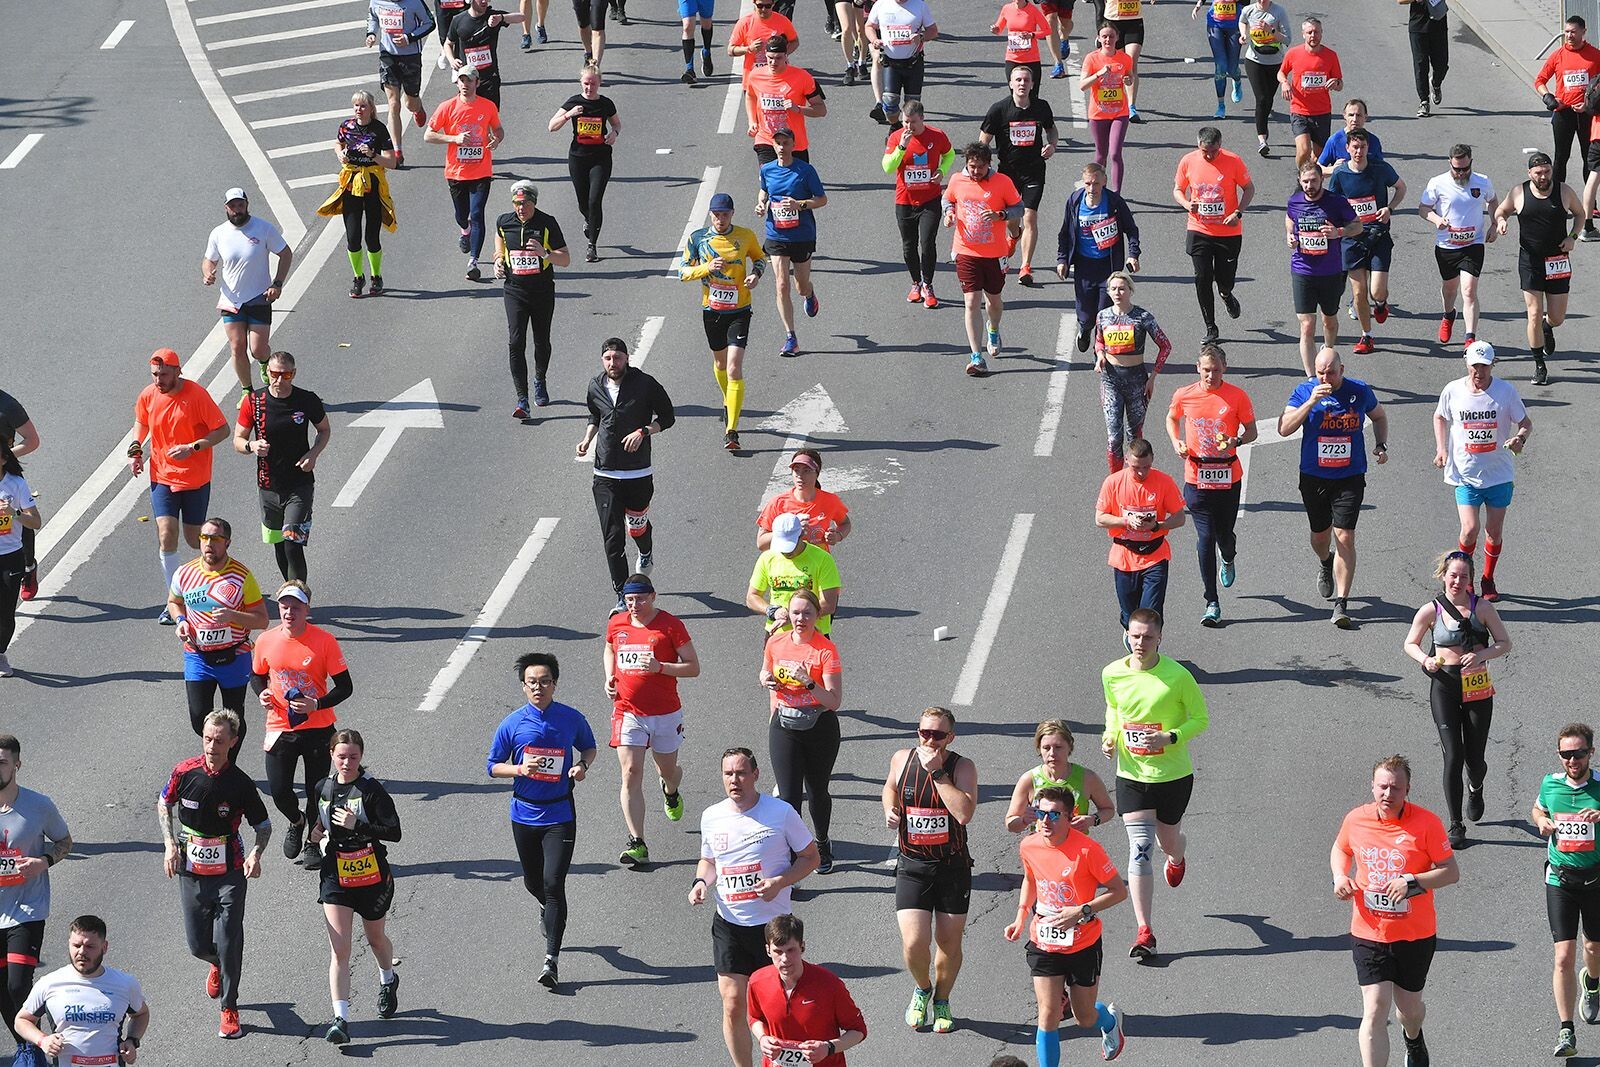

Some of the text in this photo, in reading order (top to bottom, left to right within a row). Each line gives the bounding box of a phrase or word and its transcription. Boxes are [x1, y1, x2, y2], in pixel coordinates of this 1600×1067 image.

[1119, 1, 1138, 10] 13001
[1214, 2, 1234, 11] 14961
[468, 52, 490, 63] 18481
[1304, 76, 1324, 84] 7123
[1566, 74, 1586, 82] 4055
[1103, 90, 1118, 98] 220
[579, 122, 601, 132] 16789
[1012, 130, 1034, 138] 18334
[458, 147, 482, 156] 17368
[906, 170, 928, 180] 9195
[1199, 203, 1224, 212] 15514
[1450, 232, 1474, 240] 15534
[1301, 236, 1326, 247] 12046
[512, 256, 538, 266] 12832
[1550, 260, 1568, 270] 9177
[712, 288, 735, 300] 4179
[1107, 331, 1130, 342] 9702
[1468, 430, 1493, 440] 3434
[1322, 444, 1347, 454] 2723
[1199, 470, 1229, 480] 18101
[200, 629, 226, 641] 7677
[1465, 674, 1490, 688] 1681
[534, 756, 554, 770] 32
[909, 816, 946, 828] 16733
[1558, 822, 1588, 836] 2338
[192, 846, 220, 860] 4636
[342, 857, 372, 872] 4634
[724, 873, 762, 888] 17156
[1040, 926, 1067, 940] 6155
[64, 1004, 85, 1014] 21K
[66, 1012, 116, 1022] FINISHER
